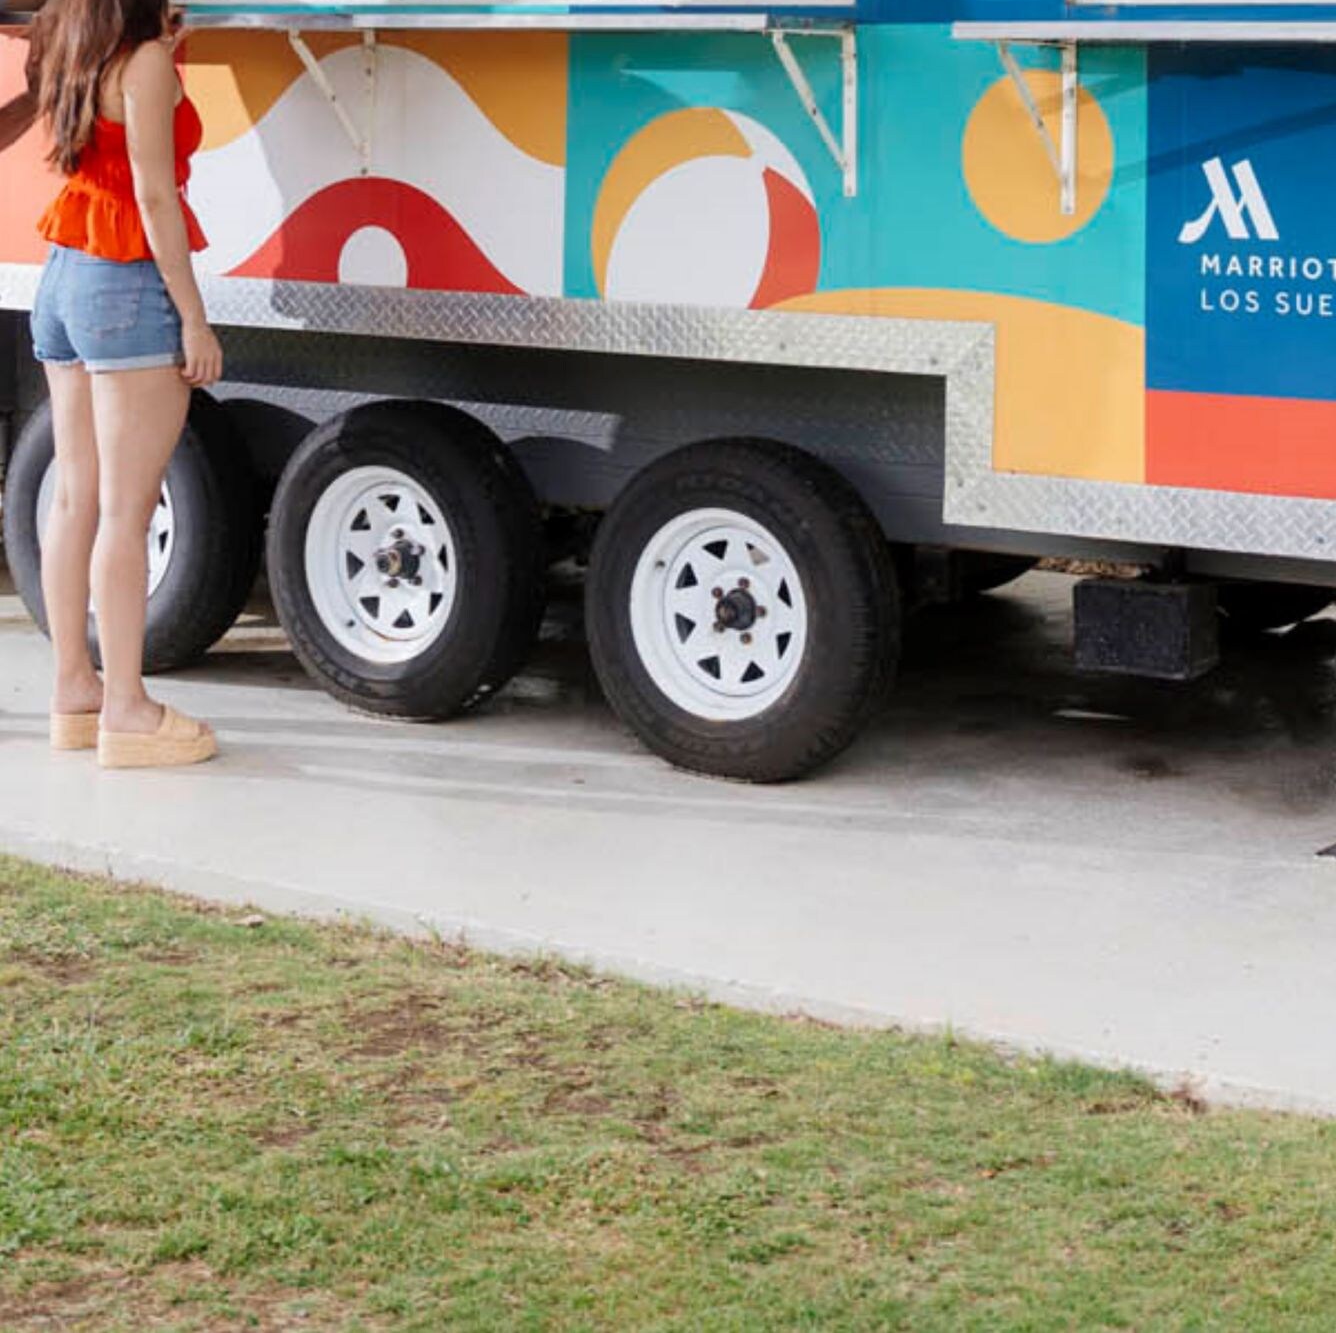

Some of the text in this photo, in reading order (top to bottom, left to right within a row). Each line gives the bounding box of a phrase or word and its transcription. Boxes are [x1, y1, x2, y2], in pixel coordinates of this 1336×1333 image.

[1201, 253, 1336, 280] MARRIOT
[1200, 288, 1334, 316] LOS SUE
